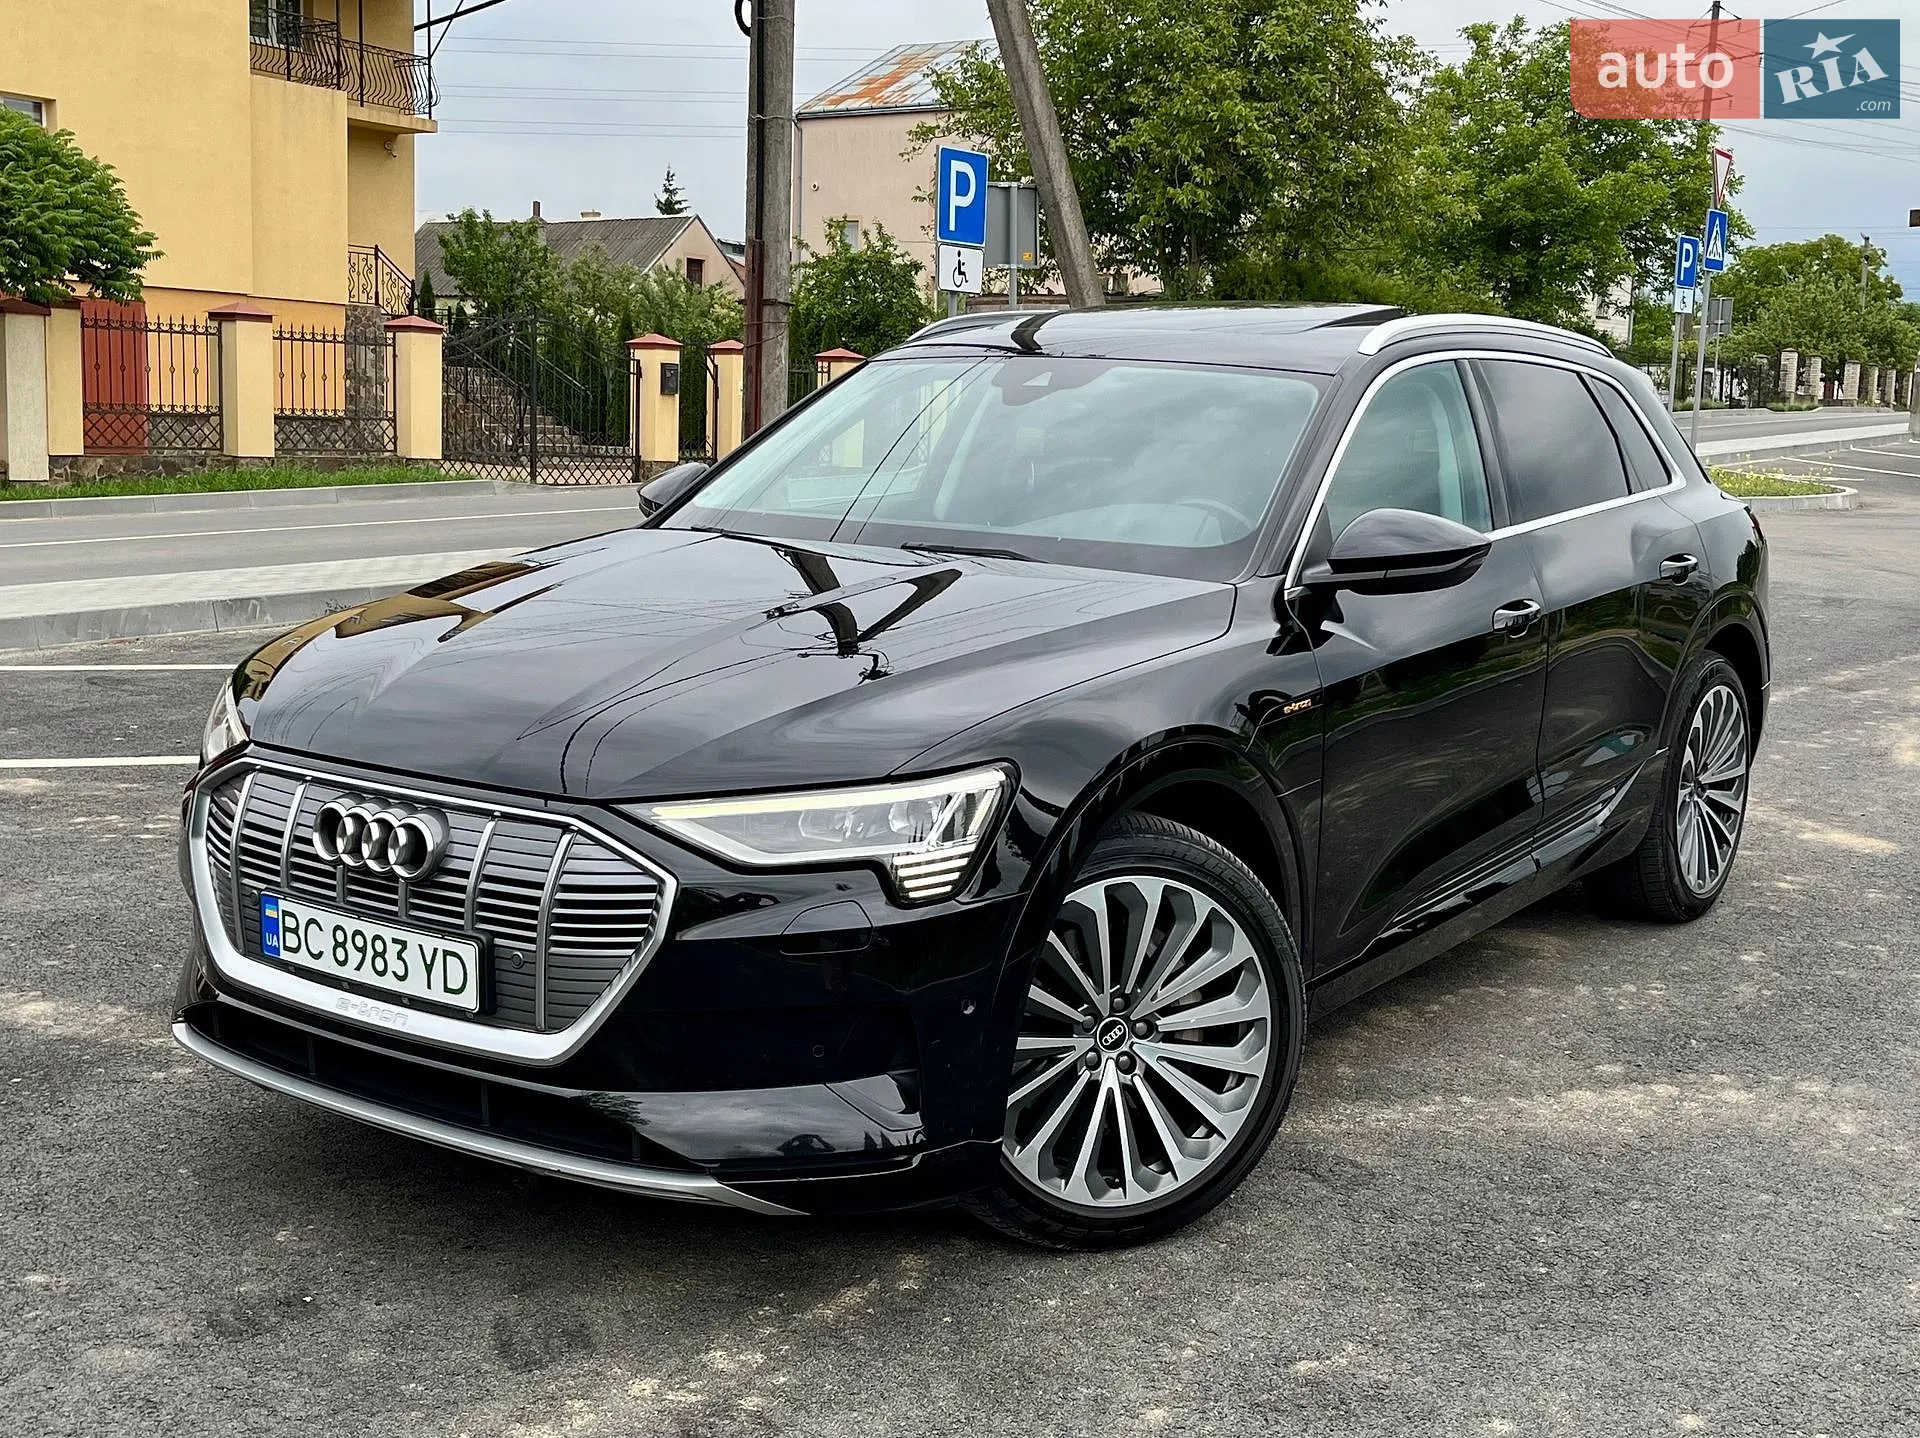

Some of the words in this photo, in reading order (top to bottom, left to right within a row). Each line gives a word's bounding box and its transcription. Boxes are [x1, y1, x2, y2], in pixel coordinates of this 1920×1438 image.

[949, 159, 976, 231] P
[1680, 243, 1694, 280] P
[265, 932, 279, 948] UA
[282, 909, 325, 961] BC
[332, 924, 409, 982] 8983
[418, 943, 468, 995] YD
